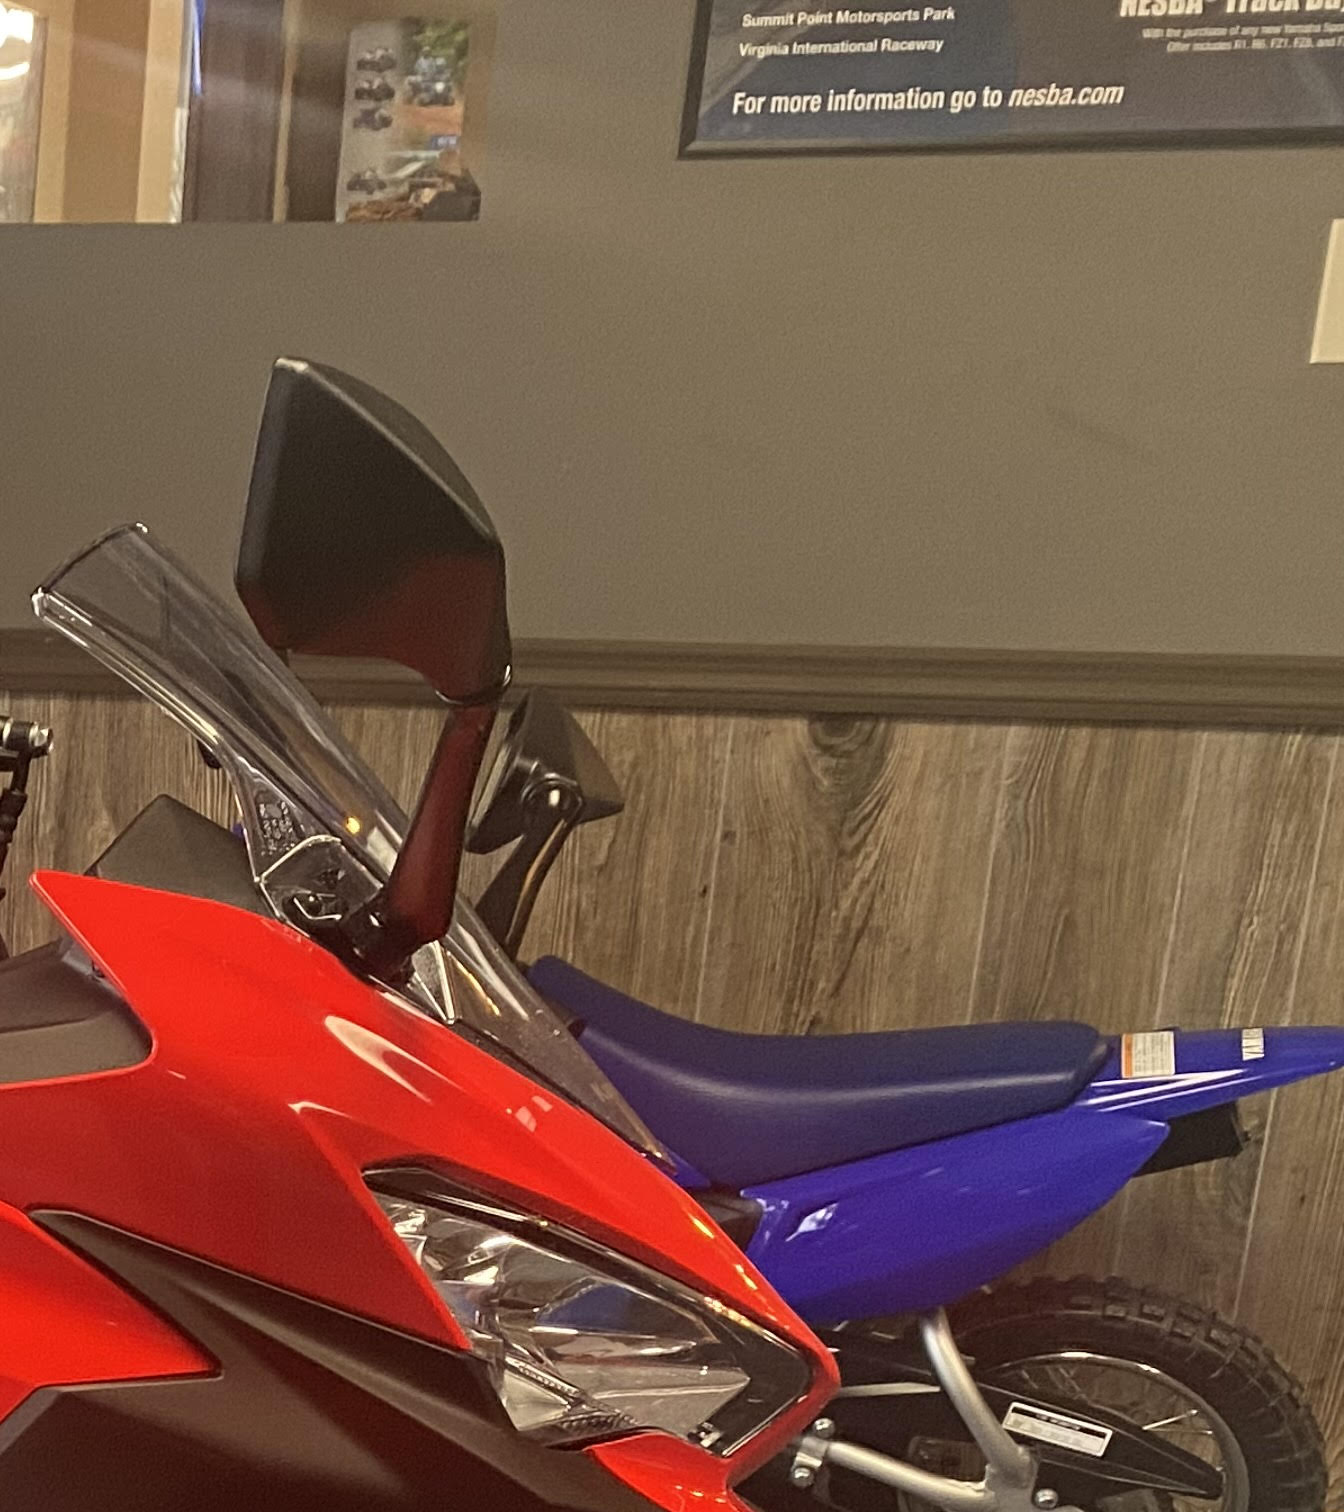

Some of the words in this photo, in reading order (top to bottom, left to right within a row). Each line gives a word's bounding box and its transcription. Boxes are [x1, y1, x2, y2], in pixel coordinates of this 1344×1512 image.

[742, 13, 794, 27] Summit
[797, 11, 833, 25] Point
[835, 9, 920, 25] Motorsports
[923, 7, 956, 21] Park
[739, 43, 789, 58] Virginia
[792, 39, 878, 55] International
[881, 38, 944, 53] Raceway
[733, 92, 766, 114] For
[770, 96, 822, 113] more
[827, 88, 945, 112] information
[950, 90, 977, 113] go
[982, 86, 1002, 107] to
[1008, 83, 1124, 107] nesba.com
